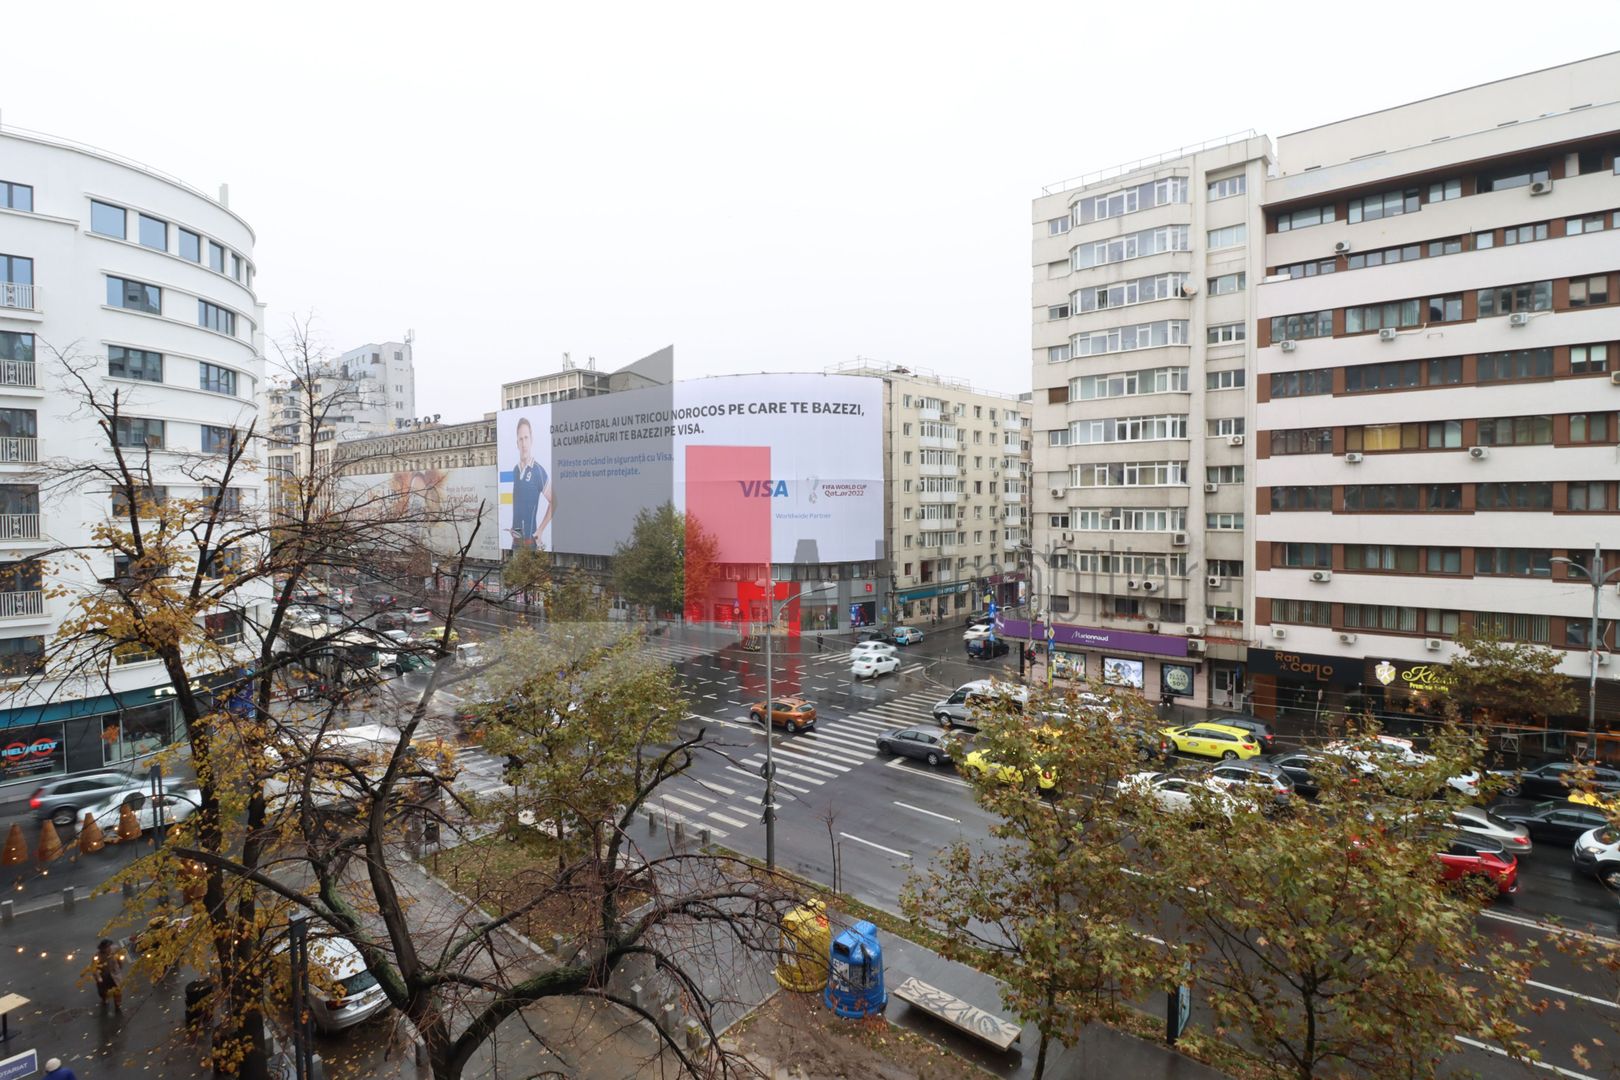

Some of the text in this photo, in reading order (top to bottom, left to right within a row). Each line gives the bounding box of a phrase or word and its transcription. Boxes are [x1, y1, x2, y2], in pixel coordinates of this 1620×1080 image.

[570, 422, 579, 432] LA
[580, 418, 610, 431] FOTBAL
[612, 417, 620, 427] AI
[621, 415, 633, 426] UN
[635, 411, 669, 424] TRICOU
[671, 404, 726, 421] NOROCOS
[728, 403, 745, 415] PE
[748, 402, 787, 414] CARE
[790, 402, 809, 414] TE
[812, 402, 865, 416] BAZEZI,
[552, 423, 704, 447] LA CUMPĂRĂTURI TE BAZEZI PE VISA.
[647, 454, 655, 462] cu
[592, 468, 606, 477] sunt
[739, 480, 789, 498] VISA
[1071, 630, 1109, 641] Marionnaud
